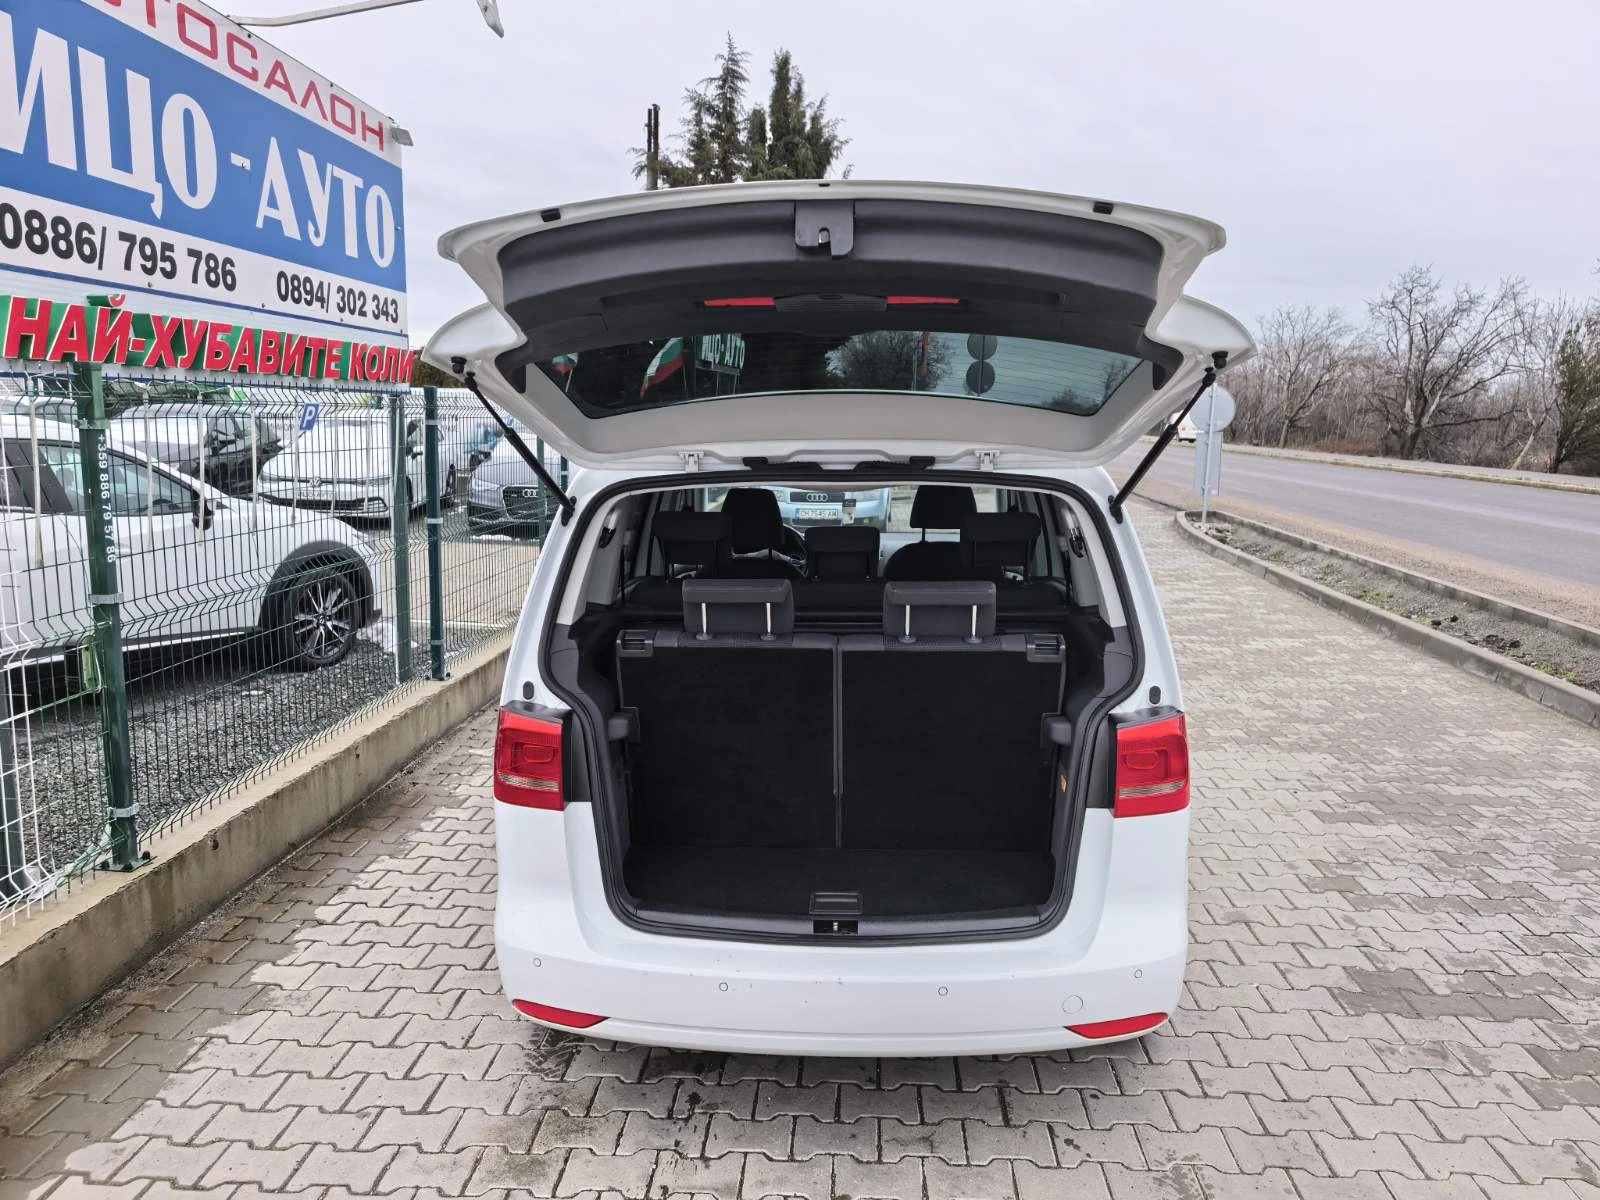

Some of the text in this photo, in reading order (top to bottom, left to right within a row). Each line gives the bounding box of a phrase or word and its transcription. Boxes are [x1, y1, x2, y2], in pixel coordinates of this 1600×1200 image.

[104, 0, 384, 152] ТОСАЛОН
[118, 231, 178, 280] 795
[187, 248, 237, 292] 786
[276, 270, 399, 324] 0894/ 302 343
[4, 293, 414, 384] НАЙ-ХУБАВИТЕ КОЛИ
[97, 435, 117, 563] +359 886 79 57 86
